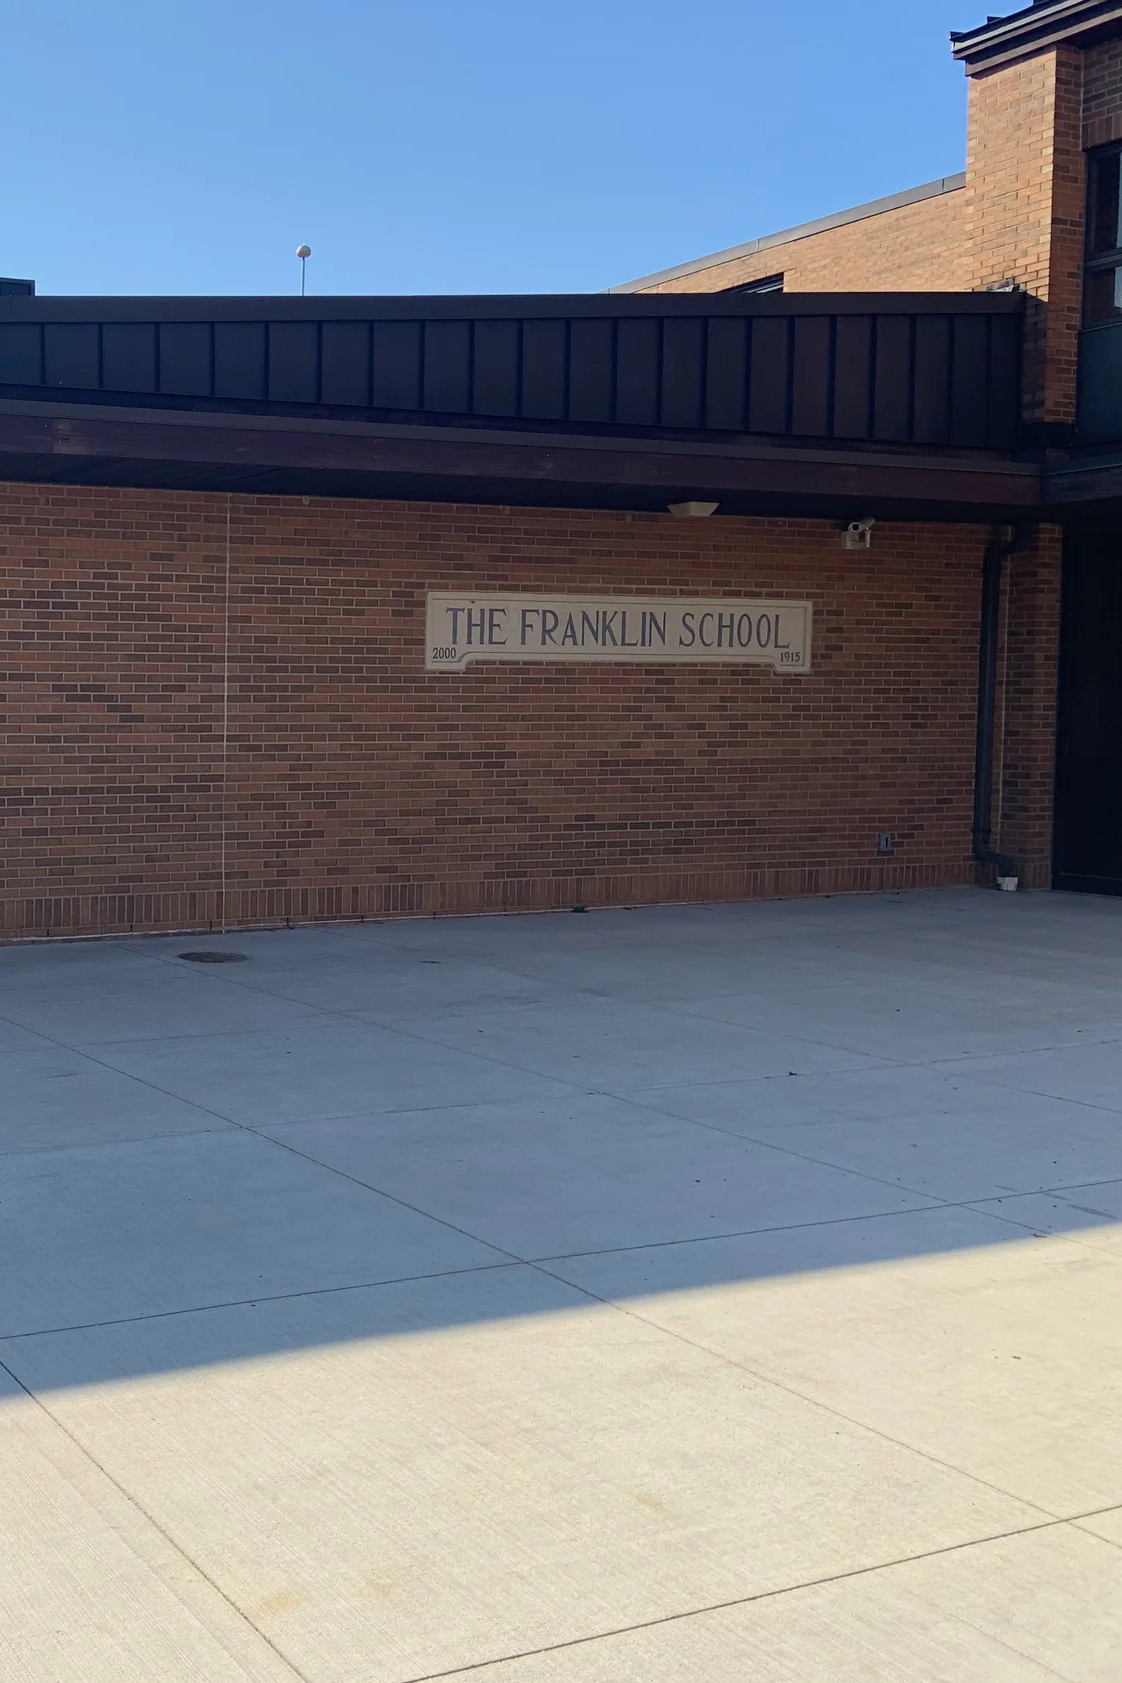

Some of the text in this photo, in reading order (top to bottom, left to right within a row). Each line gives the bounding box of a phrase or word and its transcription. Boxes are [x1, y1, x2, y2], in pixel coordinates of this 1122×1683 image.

[445, 607, 791, 649] THE FRANKLIN SCHOOL
[432, 647, 457, 660] 2000
[779, 651, 801, 663] 1915
